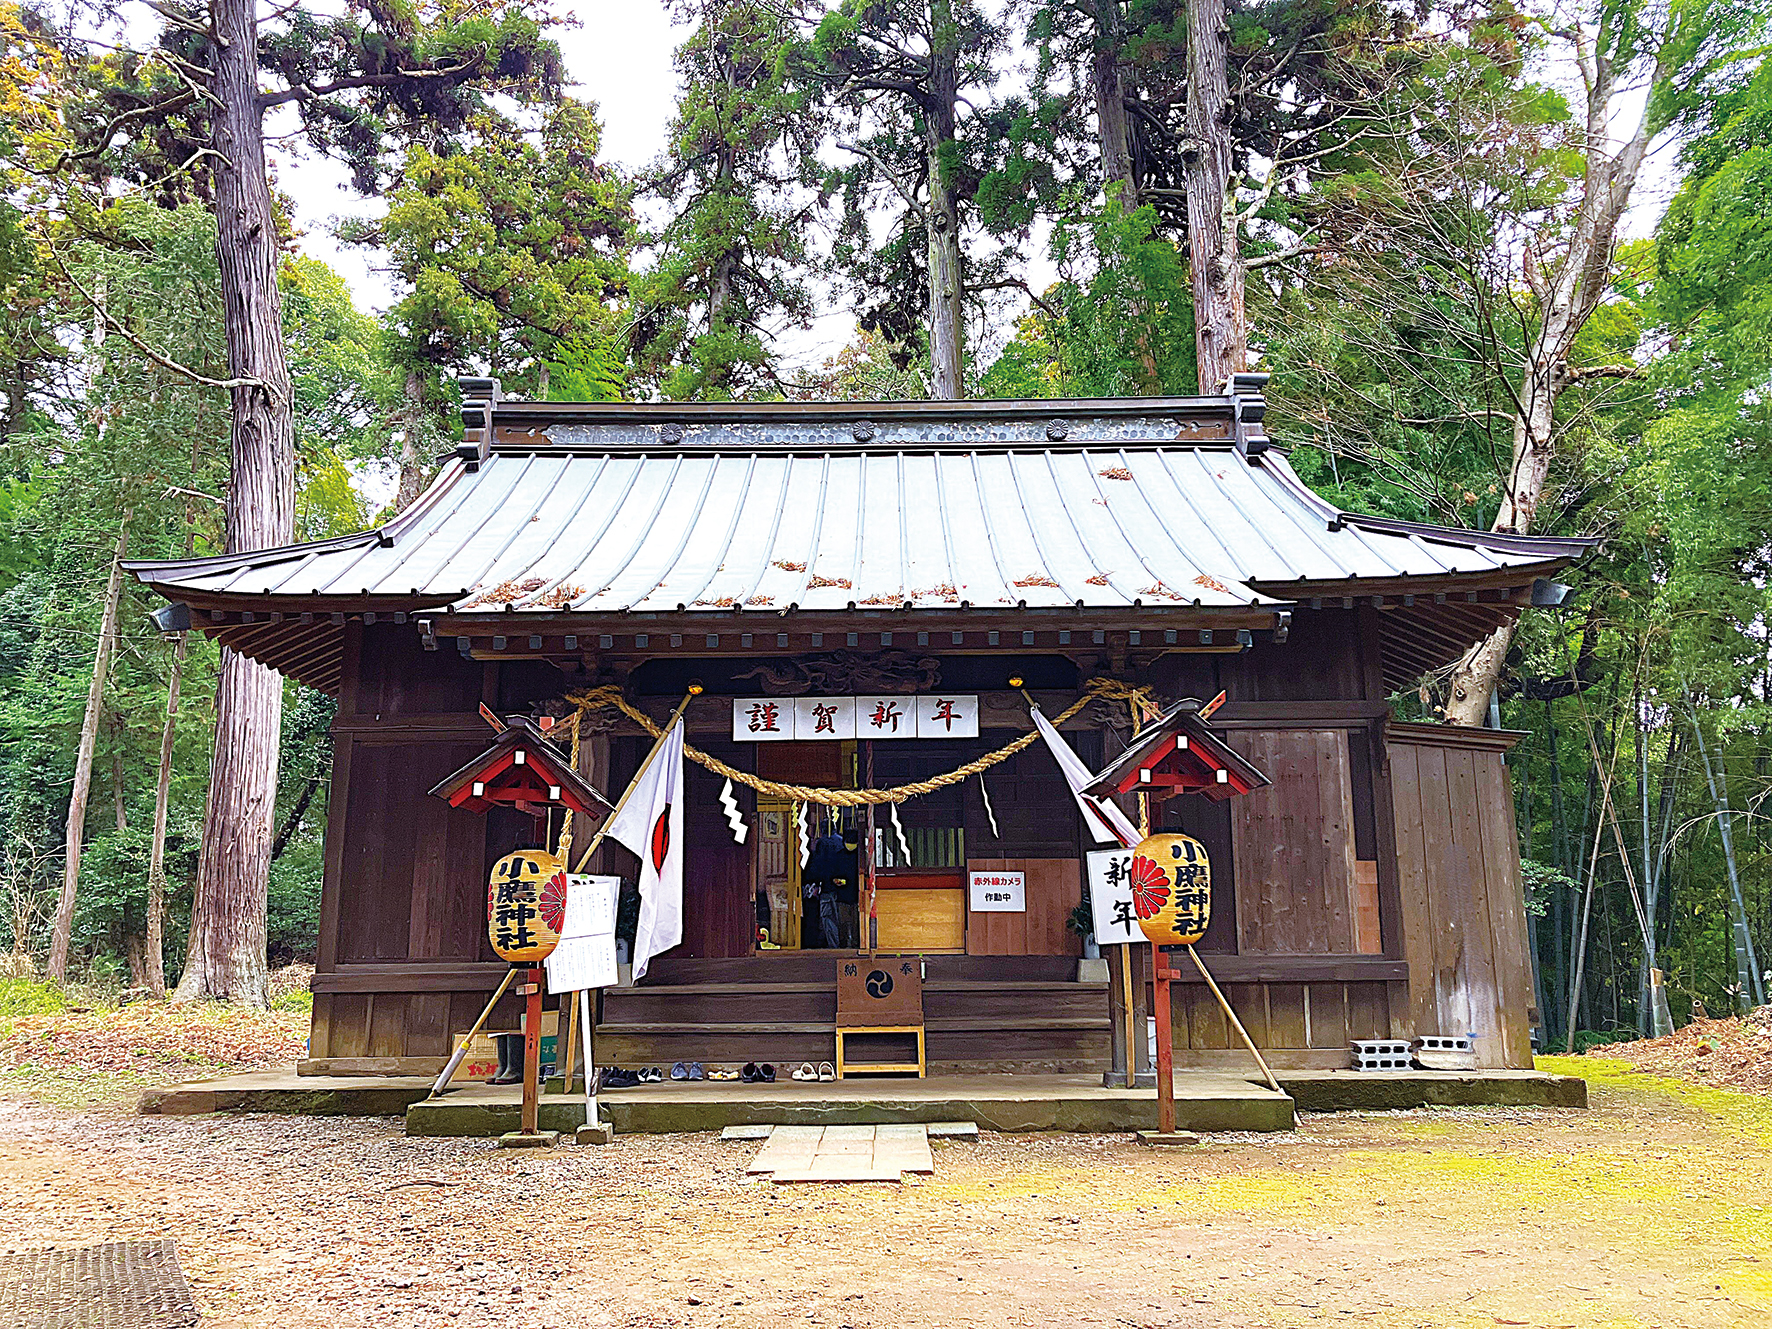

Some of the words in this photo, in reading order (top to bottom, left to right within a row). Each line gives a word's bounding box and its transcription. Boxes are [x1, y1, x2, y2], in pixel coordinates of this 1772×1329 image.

[744, 698, 963, 734] 謹賀新年
[495, 857, 540, 951] 小鷹神社
[973, 876, 1022, 886] 赤外線カメラ
[984, 892, 1012, 902] 作動中
[1103, 856, 1138, 937] 新年
[1171, 840, 1209, 936] 小鷹神社
